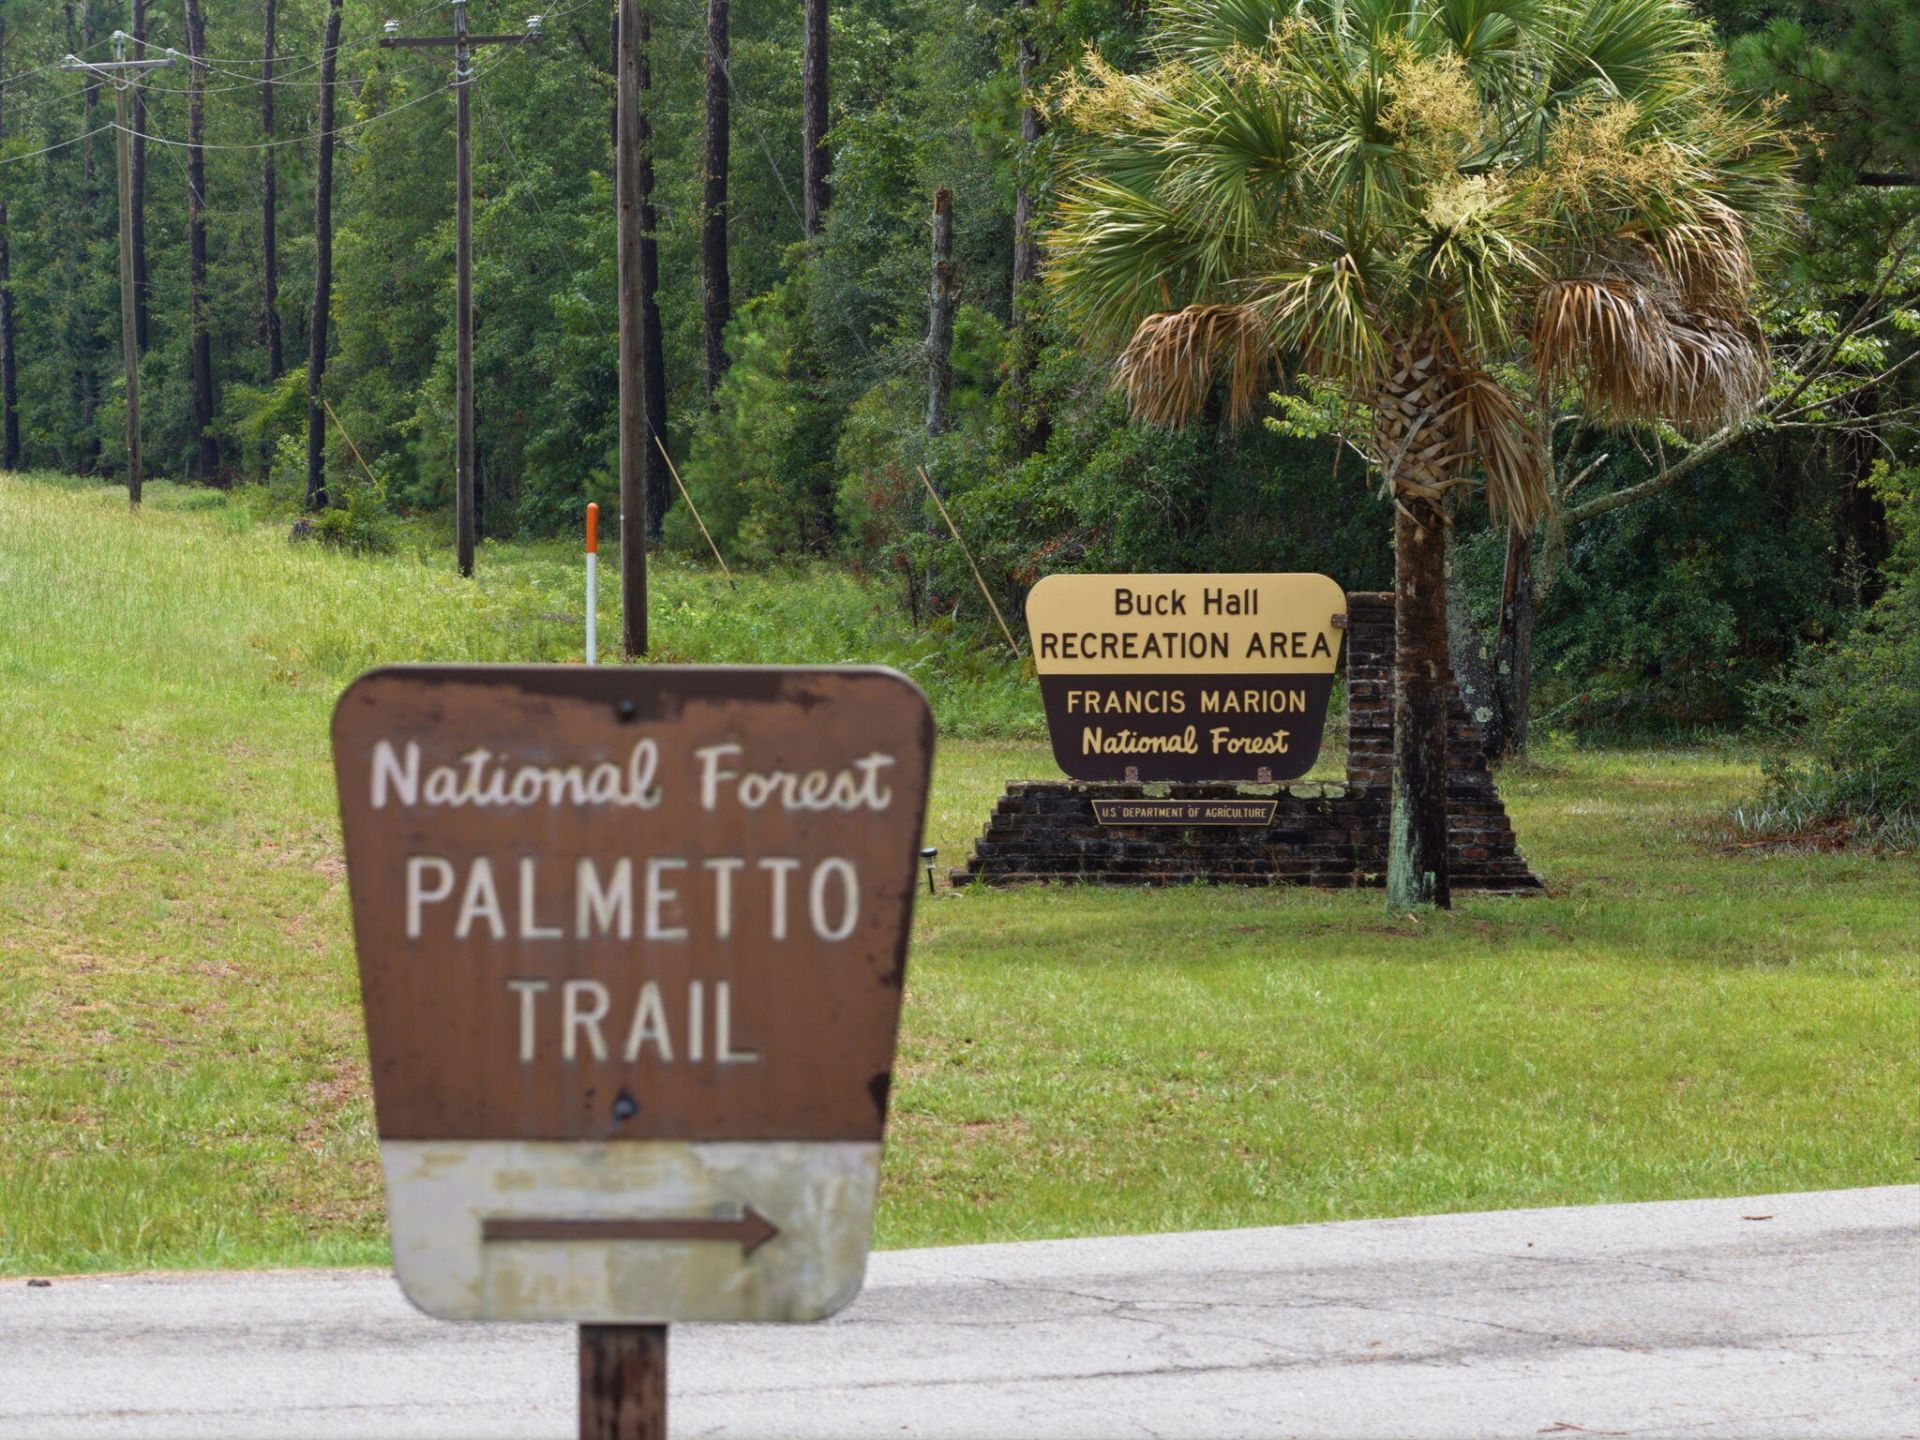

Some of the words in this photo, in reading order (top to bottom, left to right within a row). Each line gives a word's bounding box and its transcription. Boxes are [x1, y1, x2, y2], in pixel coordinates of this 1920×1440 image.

[1115, 588, 1187, 616] Buck
[1203, 588, 1258, 616] Hall
[1041, 632, 1229, 659] RECREATION
[1245, 632, 1331, 659] AREA
[1067, 690, 1186, 714] FRANCIS
[1201, 690, 1306, 713] MARION
[1082, 725, 1198, 755] National
[1210, 726, 1290, 755] Forest
[370, 738, 661, 810] National
[695, 744, 896, 811] Forest
[1122, 807, 1184, 818] DEPARTMENT
[1188, 807, 1200, 818] OF
[1205, 807, 1267, 818] AGRICULTURE
[406, 856, 860, 942] PALMETTO
[507, 980, 761, 1064] TRAIL
